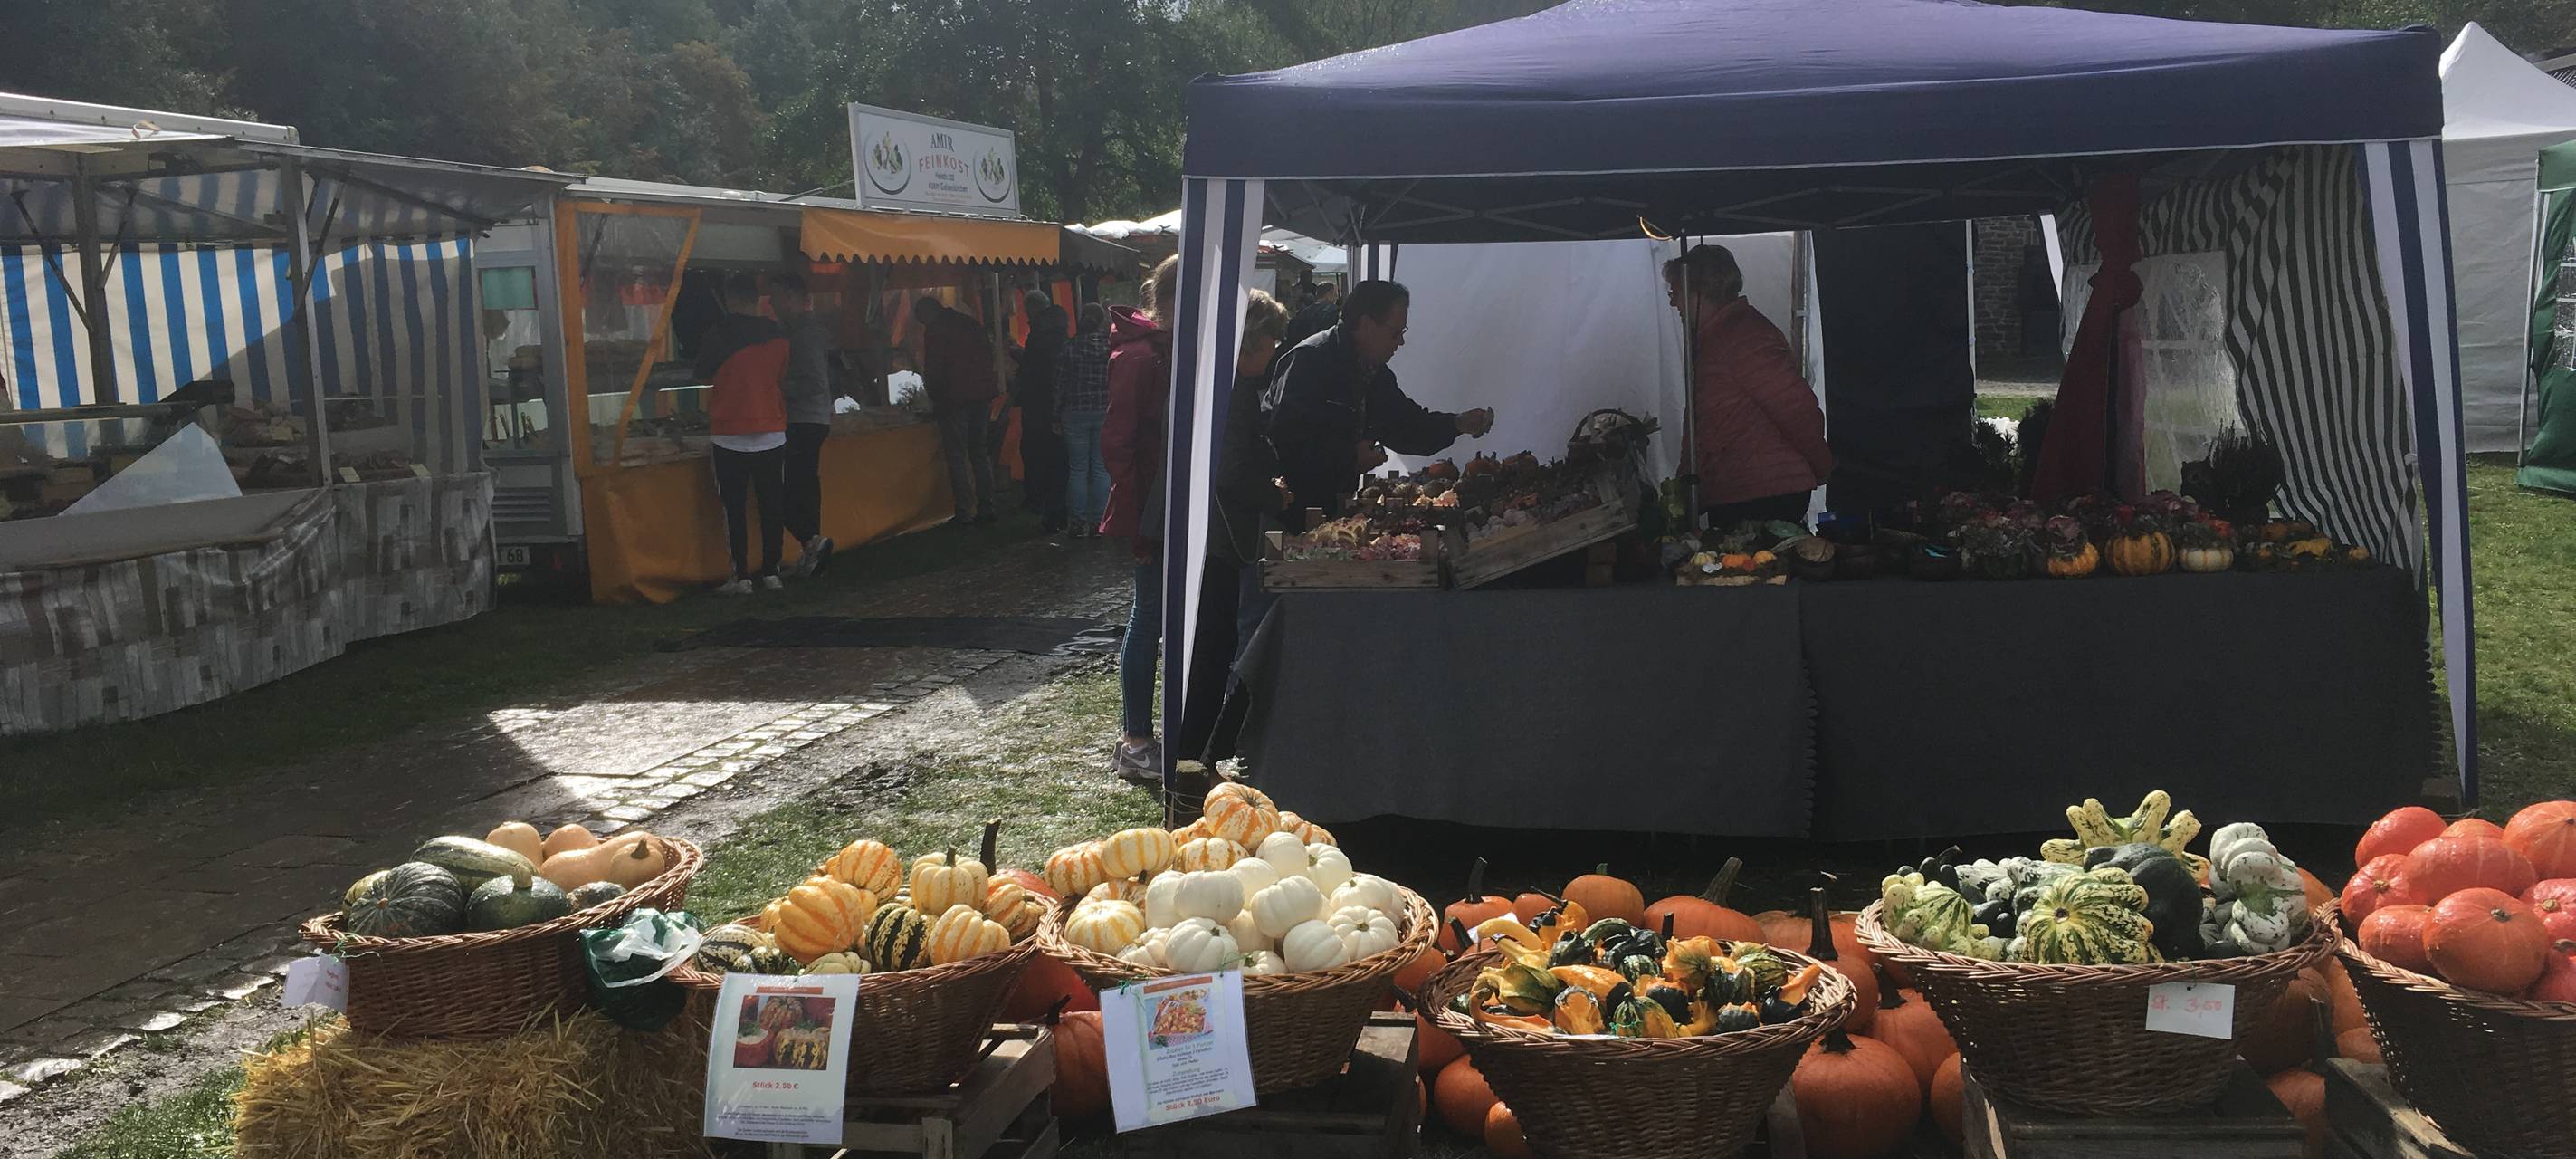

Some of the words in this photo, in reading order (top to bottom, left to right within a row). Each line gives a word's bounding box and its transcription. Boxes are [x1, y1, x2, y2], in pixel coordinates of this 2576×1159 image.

[930, 132, 955, 152] AMIR
[919, 154, 969, 177] FEINKOST
[507, 548, 523, 563] 68
[752, 1081, 774, 1089] Stück
[1165, 1102, 1185, 1111] Stück
[1204, 1095, 1221, 1103] Euro
